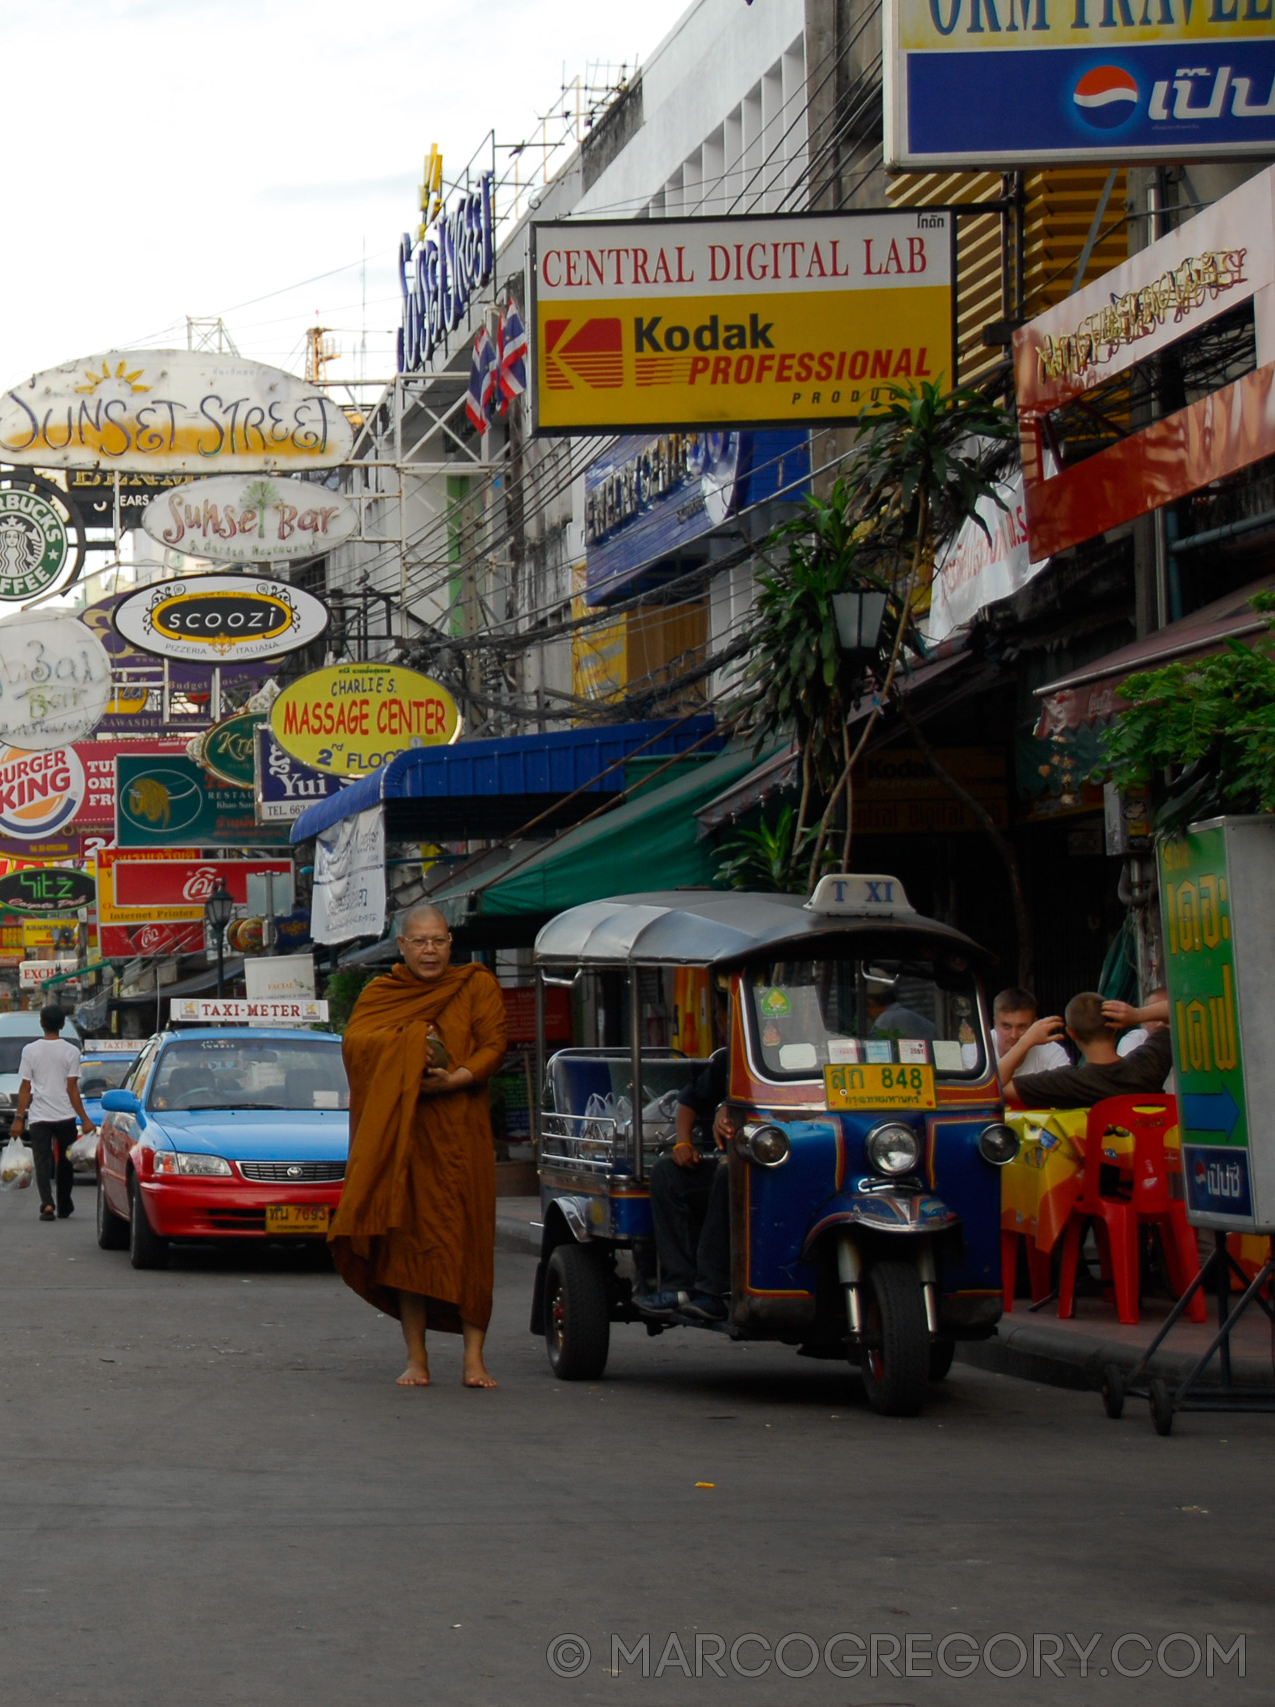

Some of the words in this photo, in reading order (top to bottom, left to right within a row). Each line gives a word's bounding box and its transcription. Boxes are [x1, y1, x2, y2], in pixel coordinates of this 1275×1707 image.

[542, 247, 695, 287] CENTRAL
[708, 240, 849, 282] DIGITAL
[863, 236, 927, 276] LAB
[634, 313, 774, 353] Kodak
[687, 347, 933, 386] PROFESSIONAL
[273, 502, 339, 541] Bar
[168, 606, 277, 629] scoozi
[165, 642, 207, 655] PIZZERIA
[236, 641, 280, 655] ITALIANA
[167, 679, 208, 690] Budget
[331, 676, 384, 697] CHARLIE
[283, 698, 370, 736] MASSAGE
[377, 697, 446, 736] CENTER
[346, 748, 406, 770] FLOO
[276, 773, 328, 797] Yui
[268, 805, 287, 816] TEL.
[110, 911, 152, 921] Internet
[157, 909, 194, 919] Printer
[202, 1003, 301, 1017] TAXI-METER
[881, 1067, 922, 1089] 848
